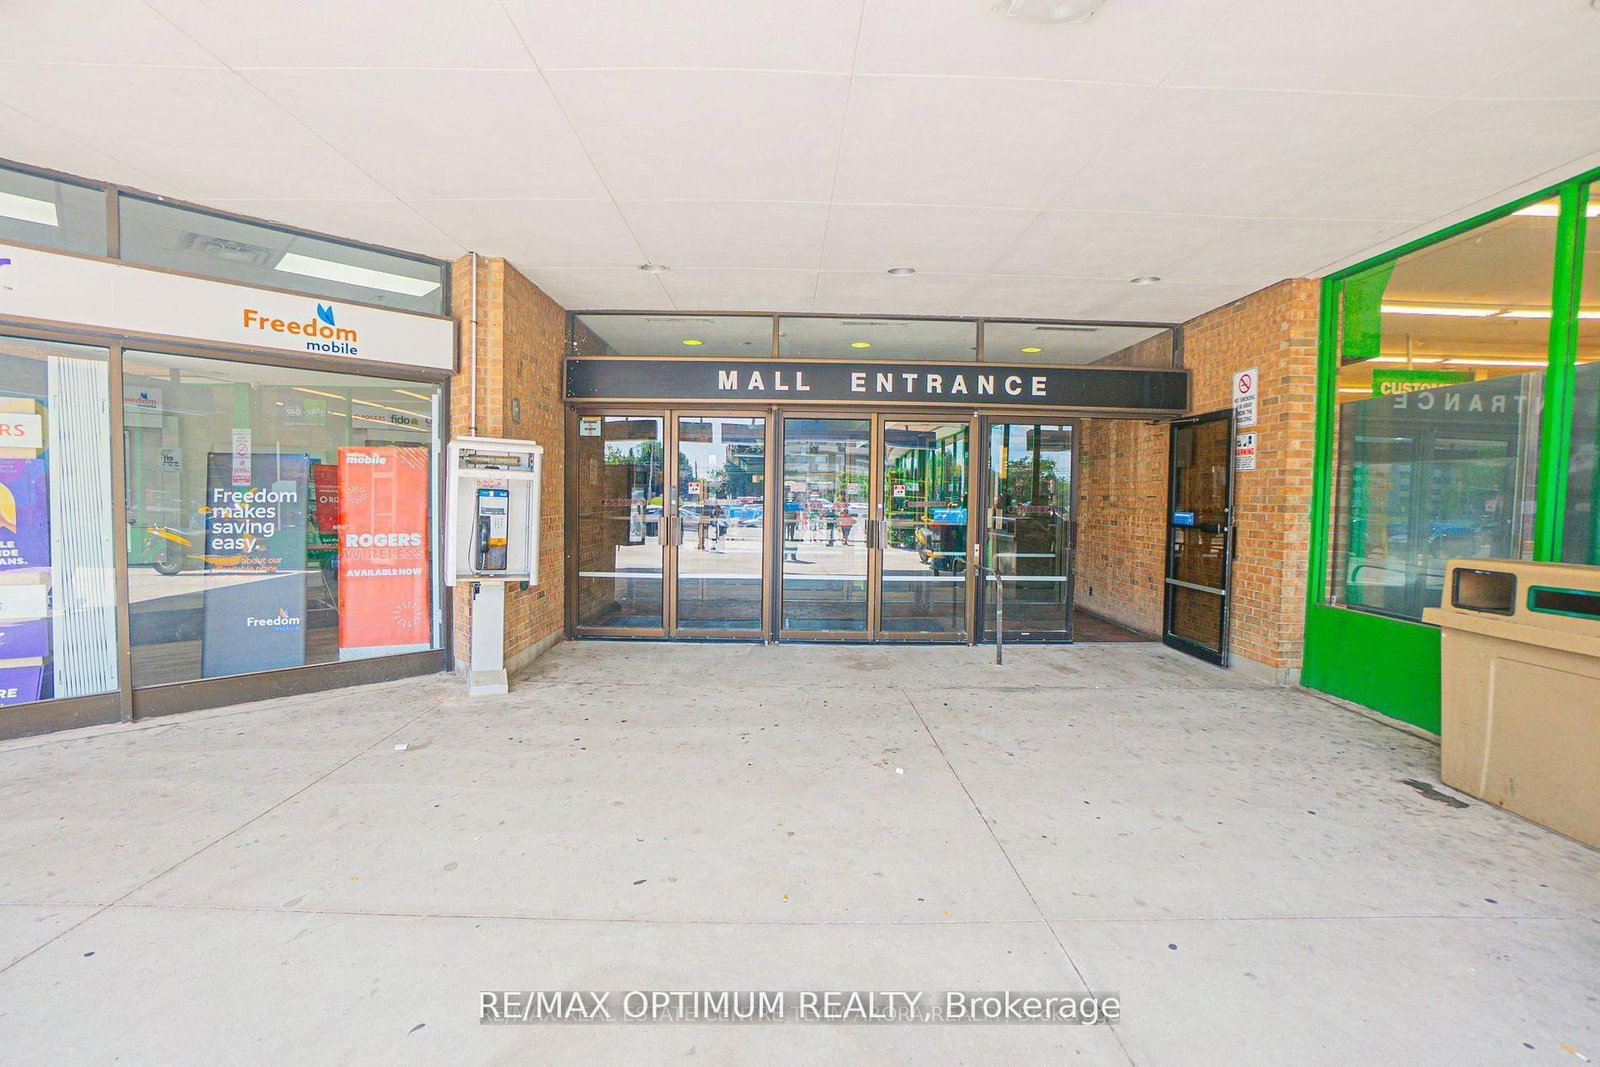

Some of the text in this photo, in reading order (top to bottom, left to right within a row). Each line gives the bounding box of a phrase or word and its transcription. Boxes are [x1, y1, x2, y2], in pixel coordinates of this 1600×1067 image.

[243, 309, 357, 342] Freedom
[306, 341, 358, 355] mobile
[717, 370, 1047, 396] MALL ENTRANCE
[391, 414, 410, 425] fido
[346, 454, 386, 464] mobile
[213, 488, 298, 503] Freedom
[212, 504, 276, 519] makes
[212, 519, 275, 537] saving
[211, 538, 260, 553] easy.
[345, 533, 422, 547] ROGERS
[343, 548, 424, 560] WIRELESS
[346, 567, 422, 577] AVAILABLE NOW
[247, 615, 300, 627] Freedom
